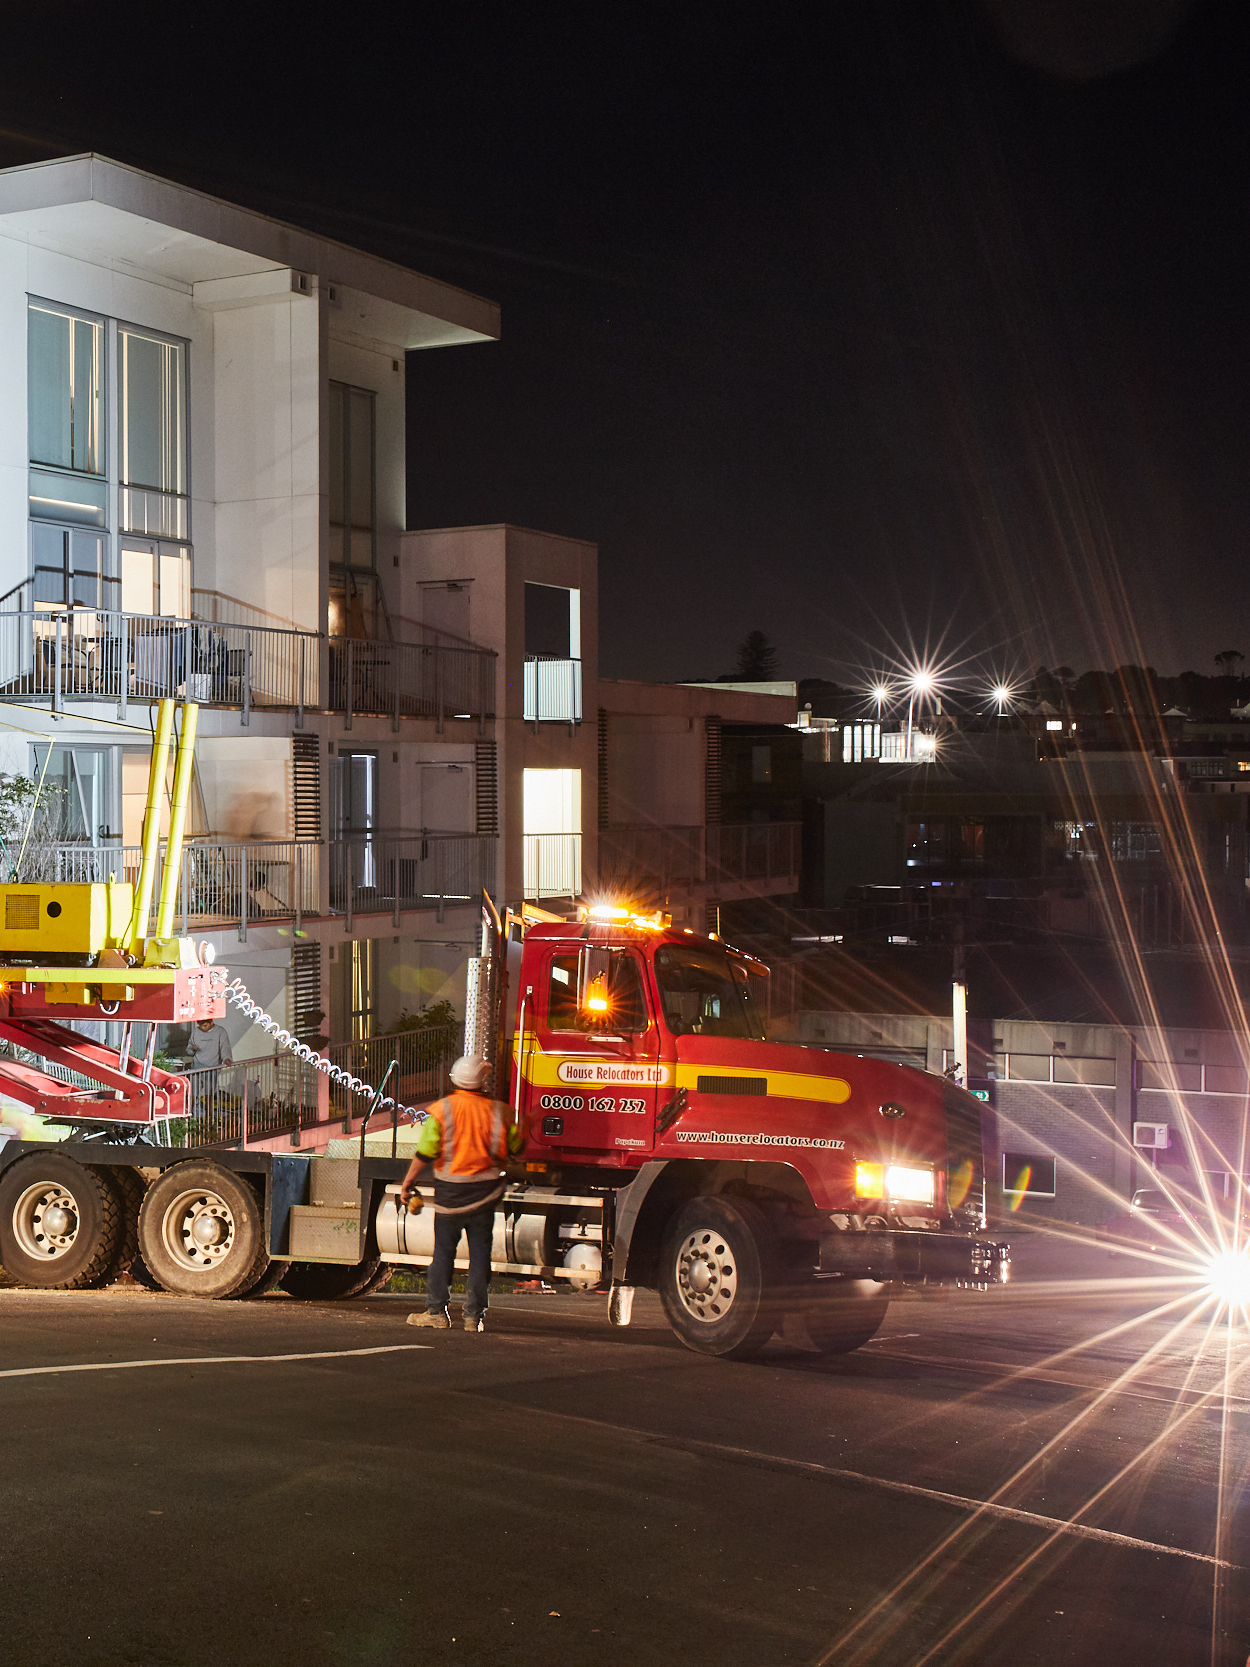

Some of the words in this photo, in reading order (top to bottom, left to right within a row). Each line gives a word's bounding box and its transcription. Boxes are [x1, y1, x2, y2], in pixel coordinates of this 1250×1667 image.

[566, 1065, 593, 1079] House
[596, 1066, 644, 1081] Relocators
[648, 1068, 662, 1082] Ltd
[540, 1095, 584, 1110] 0800
[588, 1097, 615, 1112] 162
[619, 1098, 646, 1114] 252
[676, 1131, 846, 1150] www.houserelocators.co.nz
